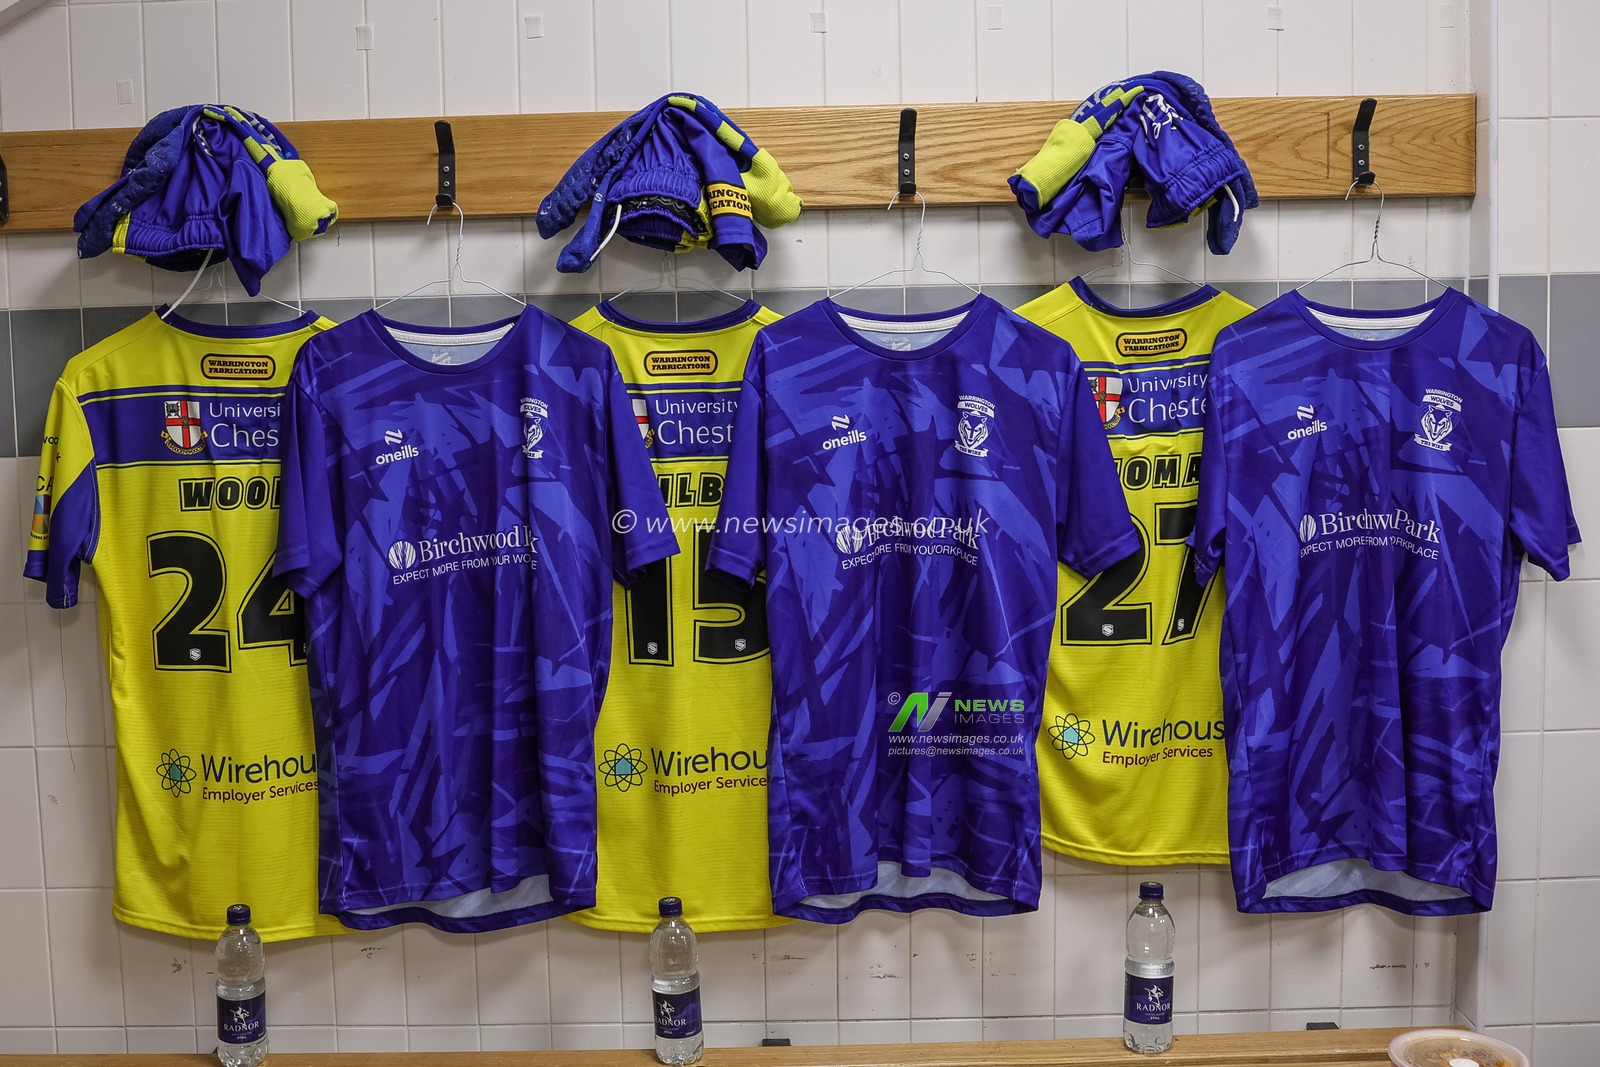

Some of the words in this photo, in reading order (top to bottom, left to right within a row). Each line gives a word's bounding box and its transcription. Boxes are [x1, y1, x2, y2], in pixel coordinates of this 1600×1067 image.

[1123, 333, 1180, 345] WARRINGTON
[1124, 341, 1179, 352] FABRICATIONS
[208, 360, 268, 368] WARRINGTON
[651, 356, 710, 364] WARRINGTON
[208, 367, 269, 375] FABRICATIONS
[958, 395, 995, 410] WARRINGTON
[1425, 388, 1463, 404] WARRINGTON
[1430, 395, 1454, 407] WOLVES
[964, 402, 988, 412] WOLVES
[210, 423, 279, 448] Ches
[1114, 452, 1202, 491] OMA
[1393, 508, 1441, 544] Park
[1335, 536, 1366, 550] MORE
[1365, 535, 1388, 547] FROM
[841, 552, 875, 571] EXPECT
[874, 543, 892, 556] ORE
[911, 545, 934, 556] YOU
[933, 544, 979, 566] ORKPLACE
[392, 568, 430, 585] EXPECT
[432, 561, 459, 577] MORE
[461, 556, 490, 570] FROM
[1061, 500, 1218, 647] 27
[146, 530, 307, 673] 24
[1101, 717, 1225, 749] Wirehous
[650, 746, 768, 777] Wirehou
[1102, 751, 1160, 769] Employer
[1162, 745, 1213, 760] Services
[201, 753, 317, 784] Wirehou
[202, 787, 266, 804] Employer
[654, 779, 712, 797] Employer
[1136, 1003, 1170, 1012] RADNOR
[223, 1021, 260, 1032] RADNOR
[655, 1015, 687, 1027] ADNOR
